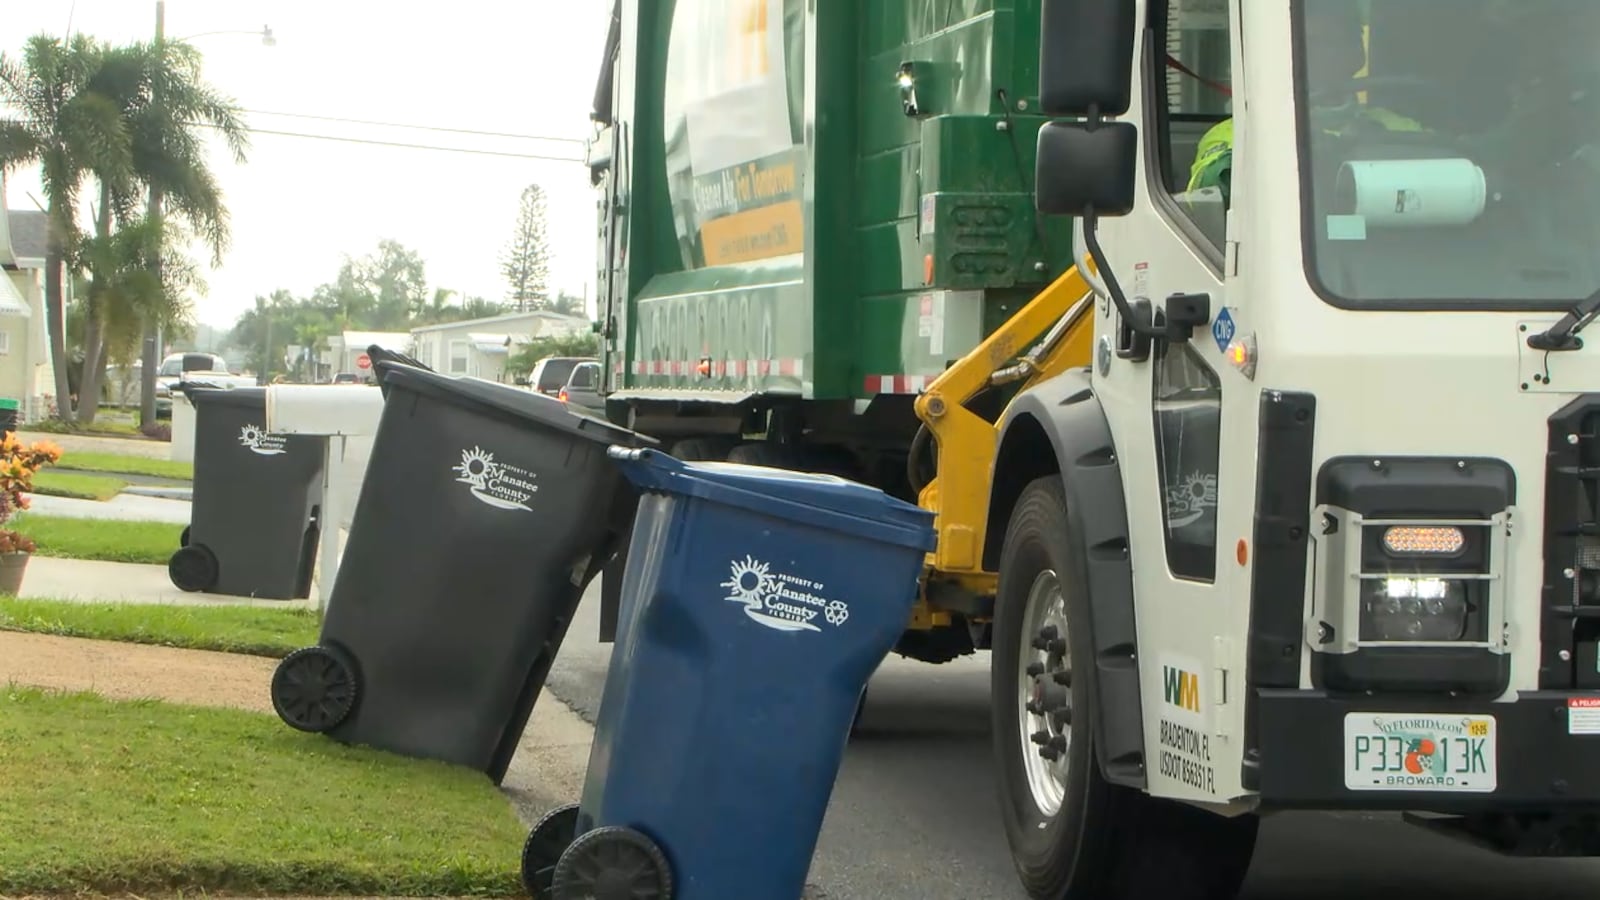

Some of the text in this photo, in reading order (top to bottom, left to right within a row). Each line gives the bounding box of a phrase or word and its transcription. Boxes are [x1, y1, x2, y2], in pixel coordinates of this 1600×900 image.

[1216, 319, 1232, 339] CNG
[489, 466, 538, 492] Manatee
[501, 463, 527, 475] PROPERTY
[488, 479, 531, 501] County
[491, 490, 521, 503] FLORIDA
[766, 579, 826, 607] Manatee
[778, 573, 824, 590] PROPERTY OF
[764, 594, 818, 620] County
[768, 609, 807, 623] FLORIDA
[1164, 665, 1199, 713] WM
[1202, 734, 1210, 761] FL
[1355, 736, 1487, 773] P33 13K
[1160, 749, 1181, 780] USDOT
[1207, 766, 1216, 794] FL
[1386, 776, 1455, 786] BROWARD
